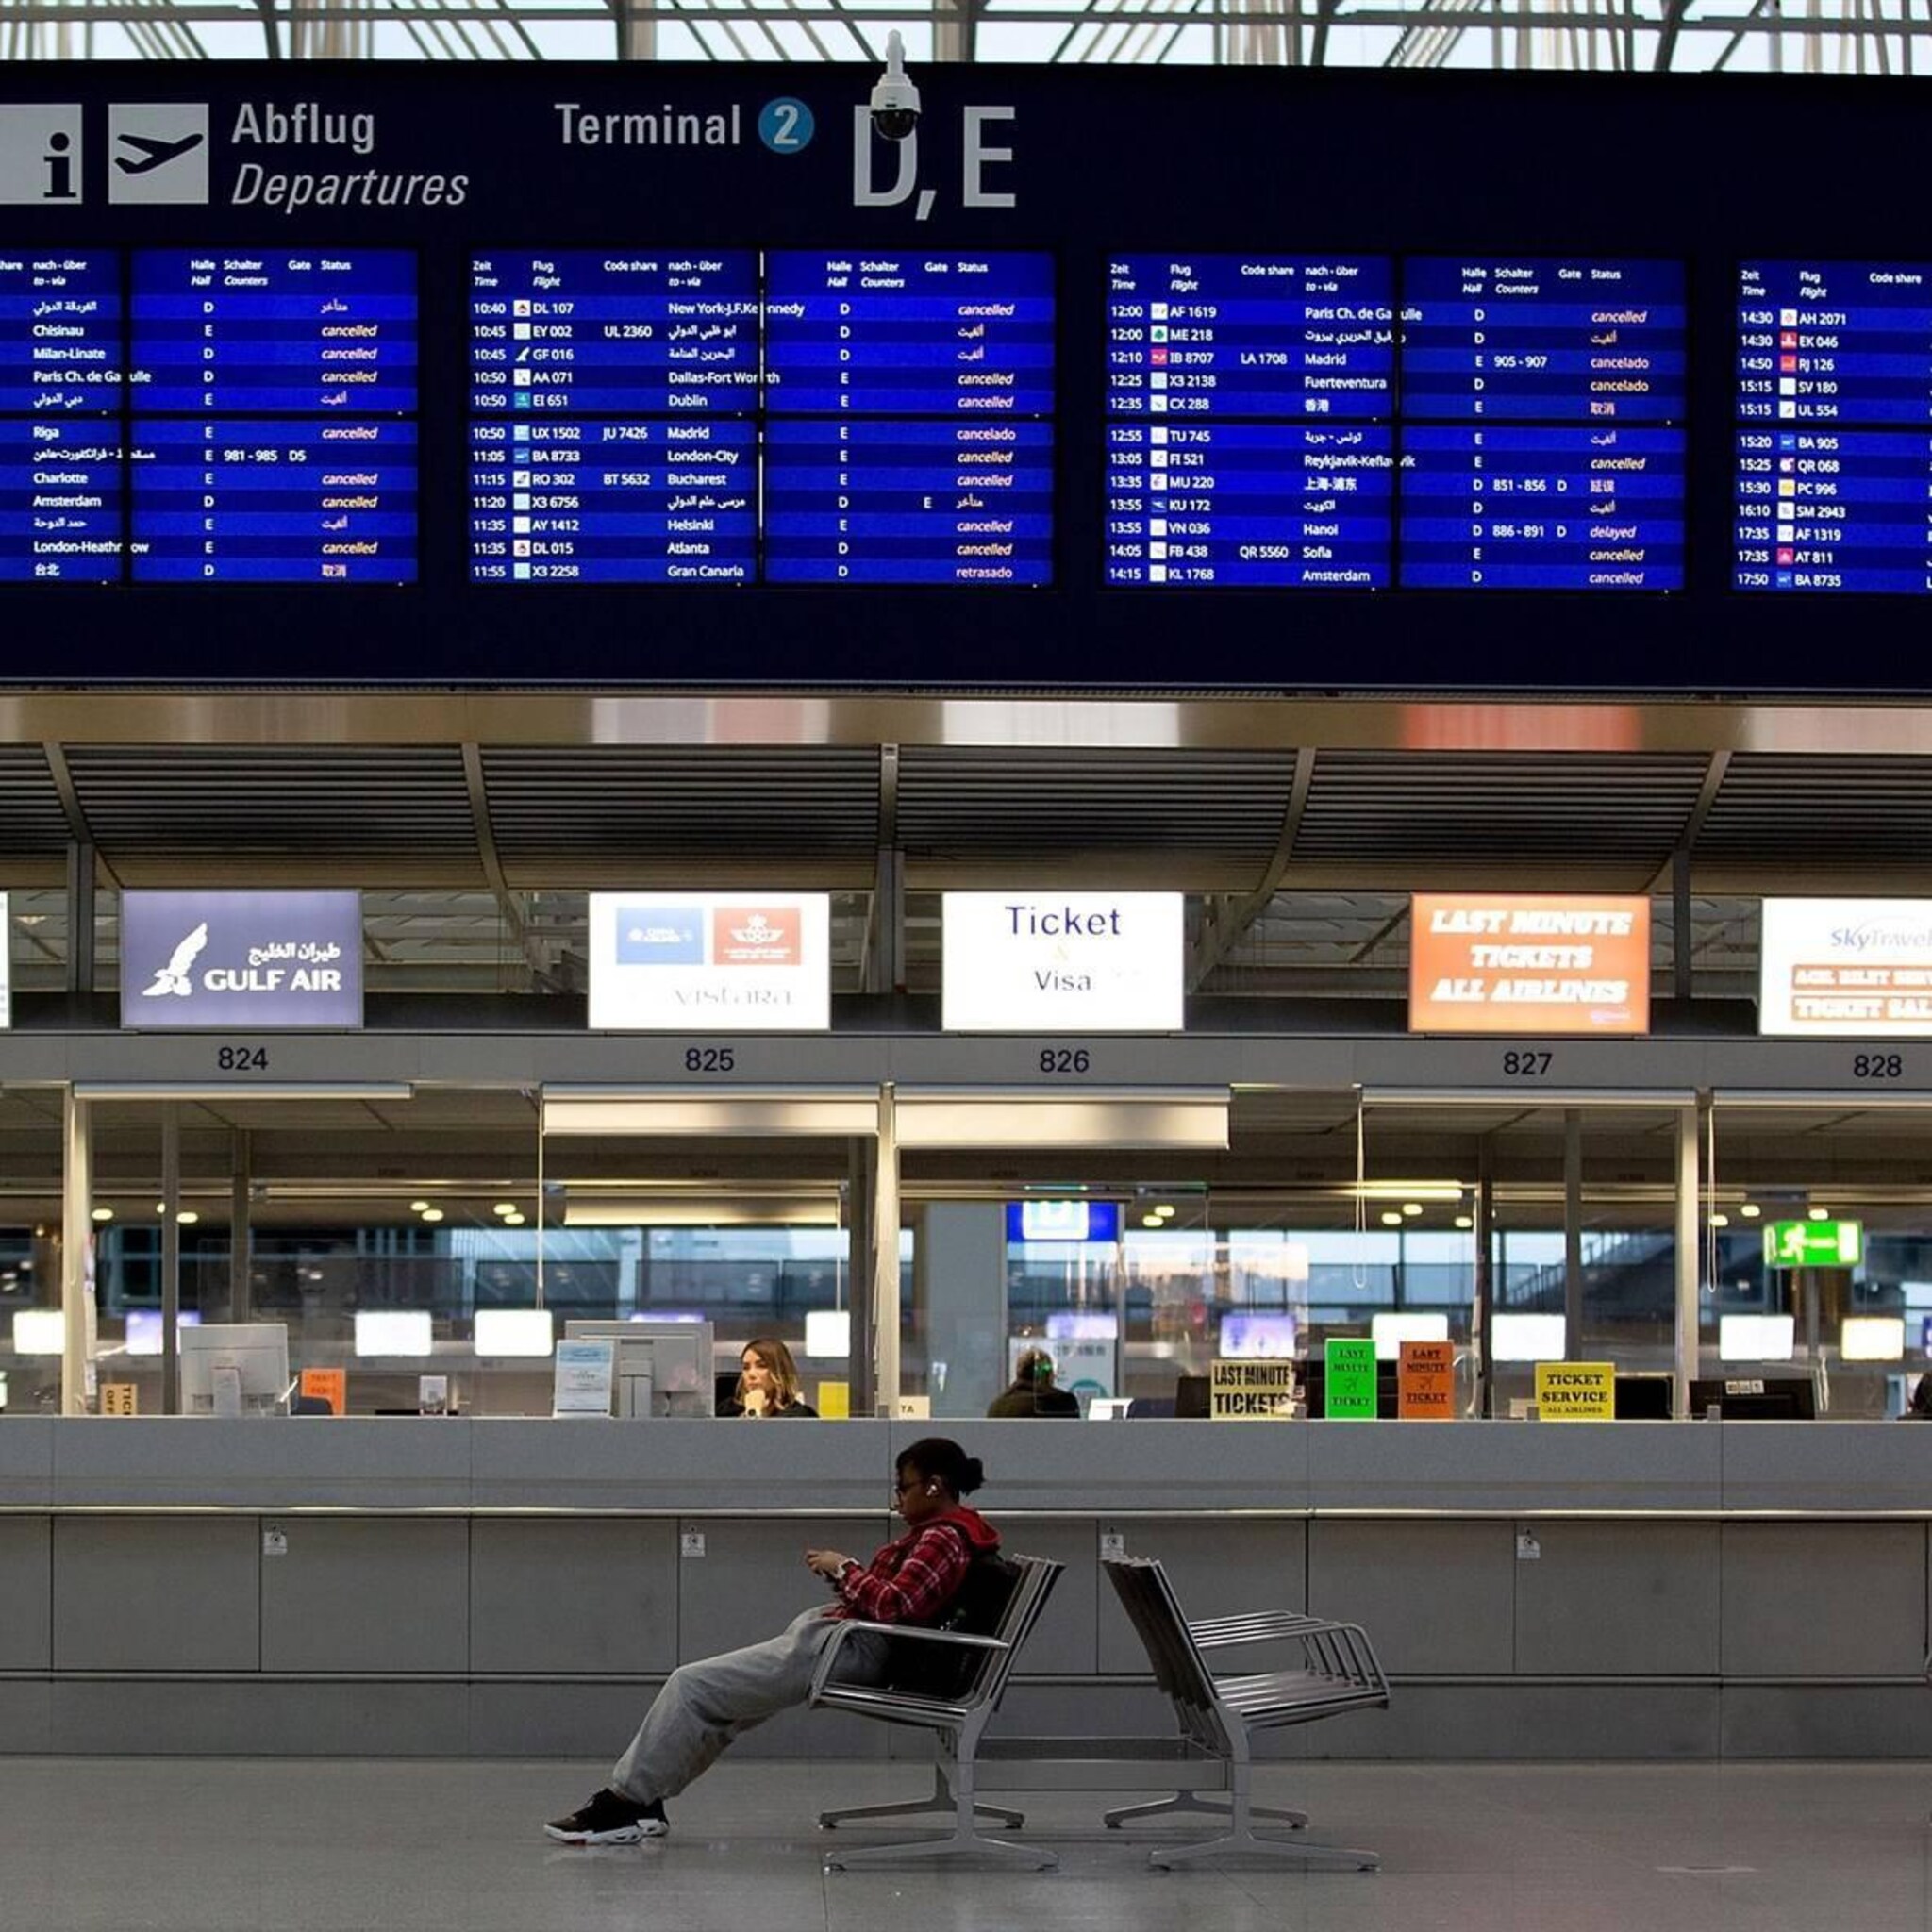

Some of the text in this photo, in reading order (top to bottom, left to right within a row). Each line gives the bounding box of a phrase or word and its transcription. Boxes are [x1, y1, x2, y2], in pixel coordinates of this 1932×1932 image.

[232, 103, 375, 155] Abflug
[555, 105, 799, 145] Terminal 2
[963, 106, 1016, 208] E
[232, 163, 468, 214] Departures
[191, 260, 351, 270] Halle Schalter Gate Status
[473, 261, 988, 273] Zeit Flug Halle Schalter Gate Status
[475, 276, 498, 286] Time
[533, 276, 560, 289] Flight
[861, 277, 905, 287] Counters
[474, 303, 1015, 315] 10:40 DL 107 cancelled
[1110, 306, 1647, 323] 12:00 AF 1619 cancelled
[1741, 311, 1773, 324] 14:30
[33, 325, 377, 337] Chisinau cancelled
[474, 325, 506, 338] 10:45
[1110, 328, 1142, 340] 12:00
[1740, 335, 1773, 346] 14:30
[34, 348, 377, 359] Milan-Linate cancelled
[474, 349, 574, 360] 10:45 GF 016
[1110, 352, 1649, 369] 12:10 Madrid cancelado
[1740, 358, 1773, 370] 14:50
[322, 371, 377, 382] cancelled
[474, 372, 1014, 385] 10:50 cancelled
[1110, 375, 1649, 391] 12:25 Fuerteventura cancelado
[1740, 380, 1772, 392] 15:15
[474, 394, 507, 407] 10:50
[669, 394, 708, 407] Dublin
[958, 396, 1014, 408] cancelled
[1110, 397, 1142, 409] 12:35
[1740, 403, 1771, 415] 15:15
[33, 426, 378, 441] Riga cancelled
[473, 427, 1016, 440] 10:50 Madrid cancelado
[1110, 430, 1142, 441] 12:55
[1740, 436, 1839, 449] 15:20 BA 905
[224, 450, 244, 461] 981
[473, 450, 1013, 464] 11:05 BA 8733 London-City cancelled
[1110, 453, 1645, 470] 13:05 cancelled
[1740, 458, 1771, 471] 15:25
[33, 472, 378, 485] Charlotte cancelled
[473, 474, 1013, 486] 11:15 Bucharest cancelled
[1110, 476, 1142, 488] 13:35
[1740, 481, 1771, 494] 15:30
[33, 495, 378, 508] Amsterdam cancelled
[473, 496, 506, 508] 11:20
[1110, 499, 1210, 511] 13:55 KU 172
[1739, 505, 1771, 517] 16:10
[473, 519, 1012, 532] 11:35 Helsinki cancelled
[1109, 522, 1637, 541] 13:55 Hanoi delayed
[1738, 527, 1770, 540] 17:35
[322, 542, 378, 554] cancelled
[474, 542, 1012, 555] 11:35 Atlanta cancelled
[1109, 545, 1644, 561] 14:05 Sofia cancelled
[1738, 550, 1769, 562] 17:35
[474, 565, 1012, 578] 11:55 Gran Canaria retrasado
[1109, 568, 1643, 584] 14:15 Amsterdam cancelled
[1737, 573, 1841, 587] 17:50 BA 8735
[1005, 906, 1121, 935] Ticket
[1430, 909, 1633, 935] LAST MINUTE
[248, 942, 341, 966] طيران الخليج
[1470, 945, 1593, 968] TICKETS
[204, 970, 341, 991] GULF AIR
[1034, 970, 1091, 991] Visa
[1430, 978, 1629, 1004] ALL AIRLINES
[218, 1047, 268, 1071] 824
[685, 1049, 734, 1073] 825
[1040, 1049, 1090, 1073] 826
[1503, 1053, 1552, 1075] 827
[1854, 1055, 1902, 1078] 828
[1412, 1349, 1441, 1359] LAST
[1214, 1365, 1290, 1386] LAST MINUTE
[1547, 1374, 1603, 1386] TICKET
[122, 1387, 132, 1416] TIC
[1332, 1396, 1370, 1407] TICKET
[1407, 1393, 1447, 1404] TICKET
[1541, 1391, 1607, 1403] SERVICE
